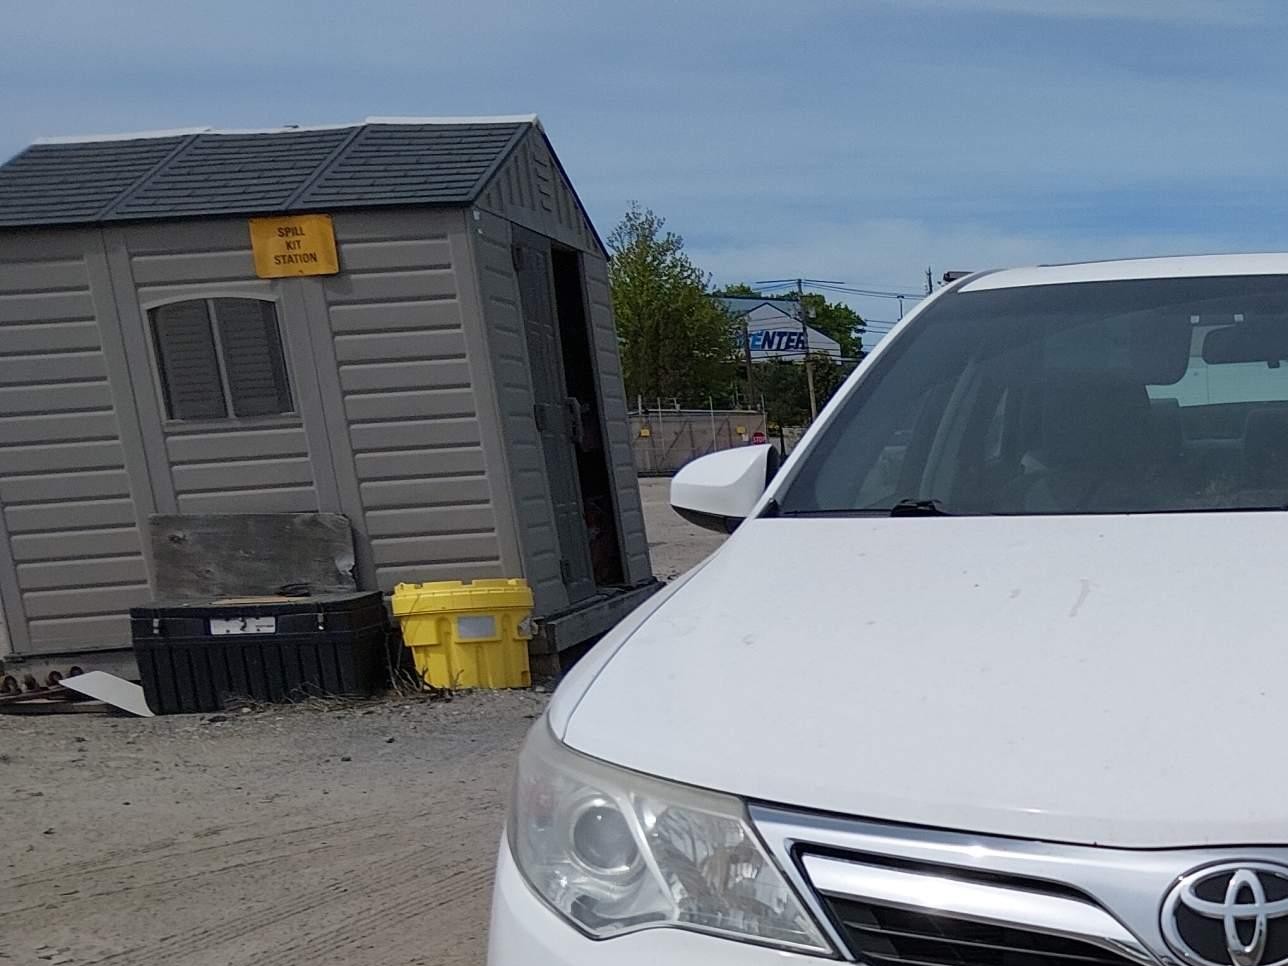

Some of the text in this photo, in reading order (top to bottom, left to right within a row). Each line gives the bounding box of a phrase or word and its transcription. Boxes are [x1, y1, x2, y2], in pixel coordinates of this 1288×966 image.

[277, 226, 306, 238] SPILL
[285, 239, 303, 251] KIT
[273, 252, 318, 265] STATION
[738, 330, 808, 350] ENTER
